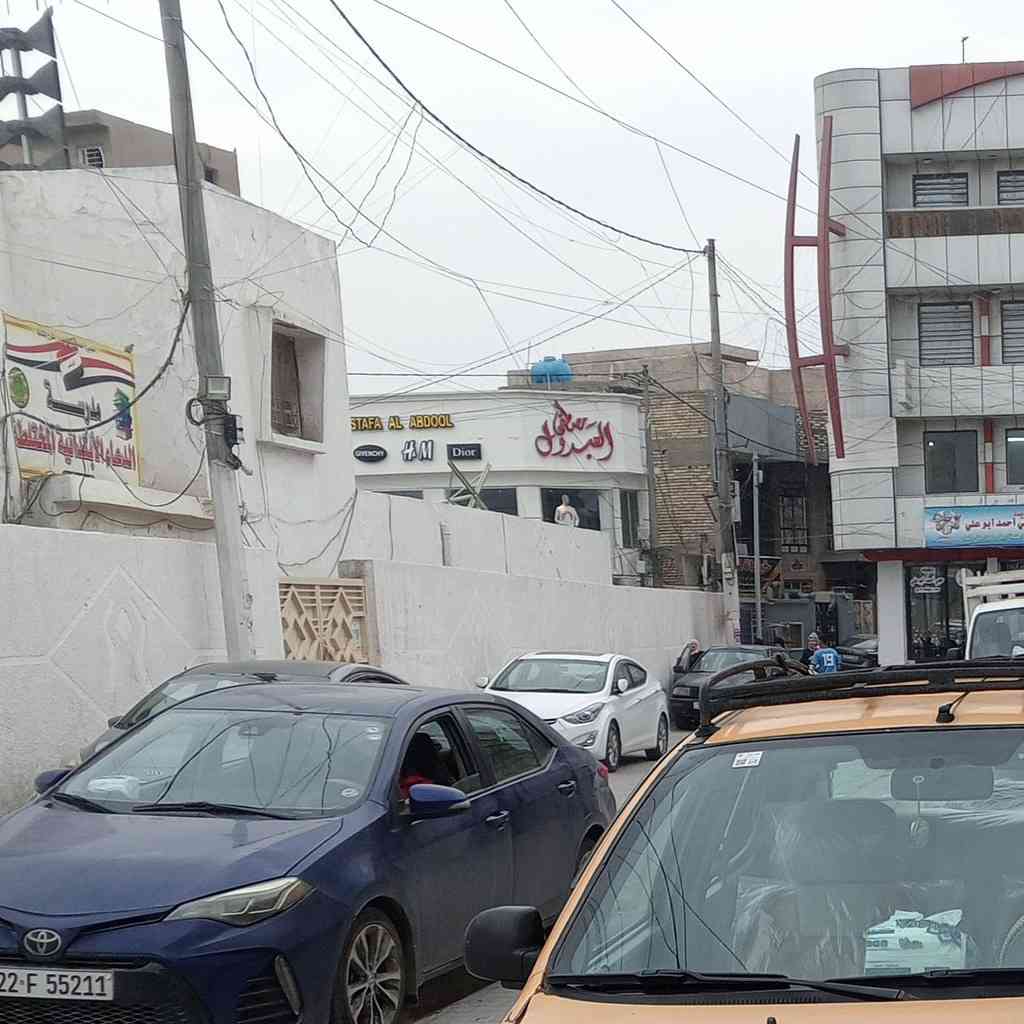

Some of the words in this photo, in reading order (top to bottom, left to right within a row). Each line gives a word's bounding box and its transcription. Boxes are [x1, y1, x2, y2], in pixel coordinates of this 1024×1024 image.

[388, 416, 404, 431] AL
[409, 413, 455, 430] ABDOOL
[452, 447, 477, 457] Dior
[26, 973, 38, 994] F
[46, 973, 107, 997] 55211
